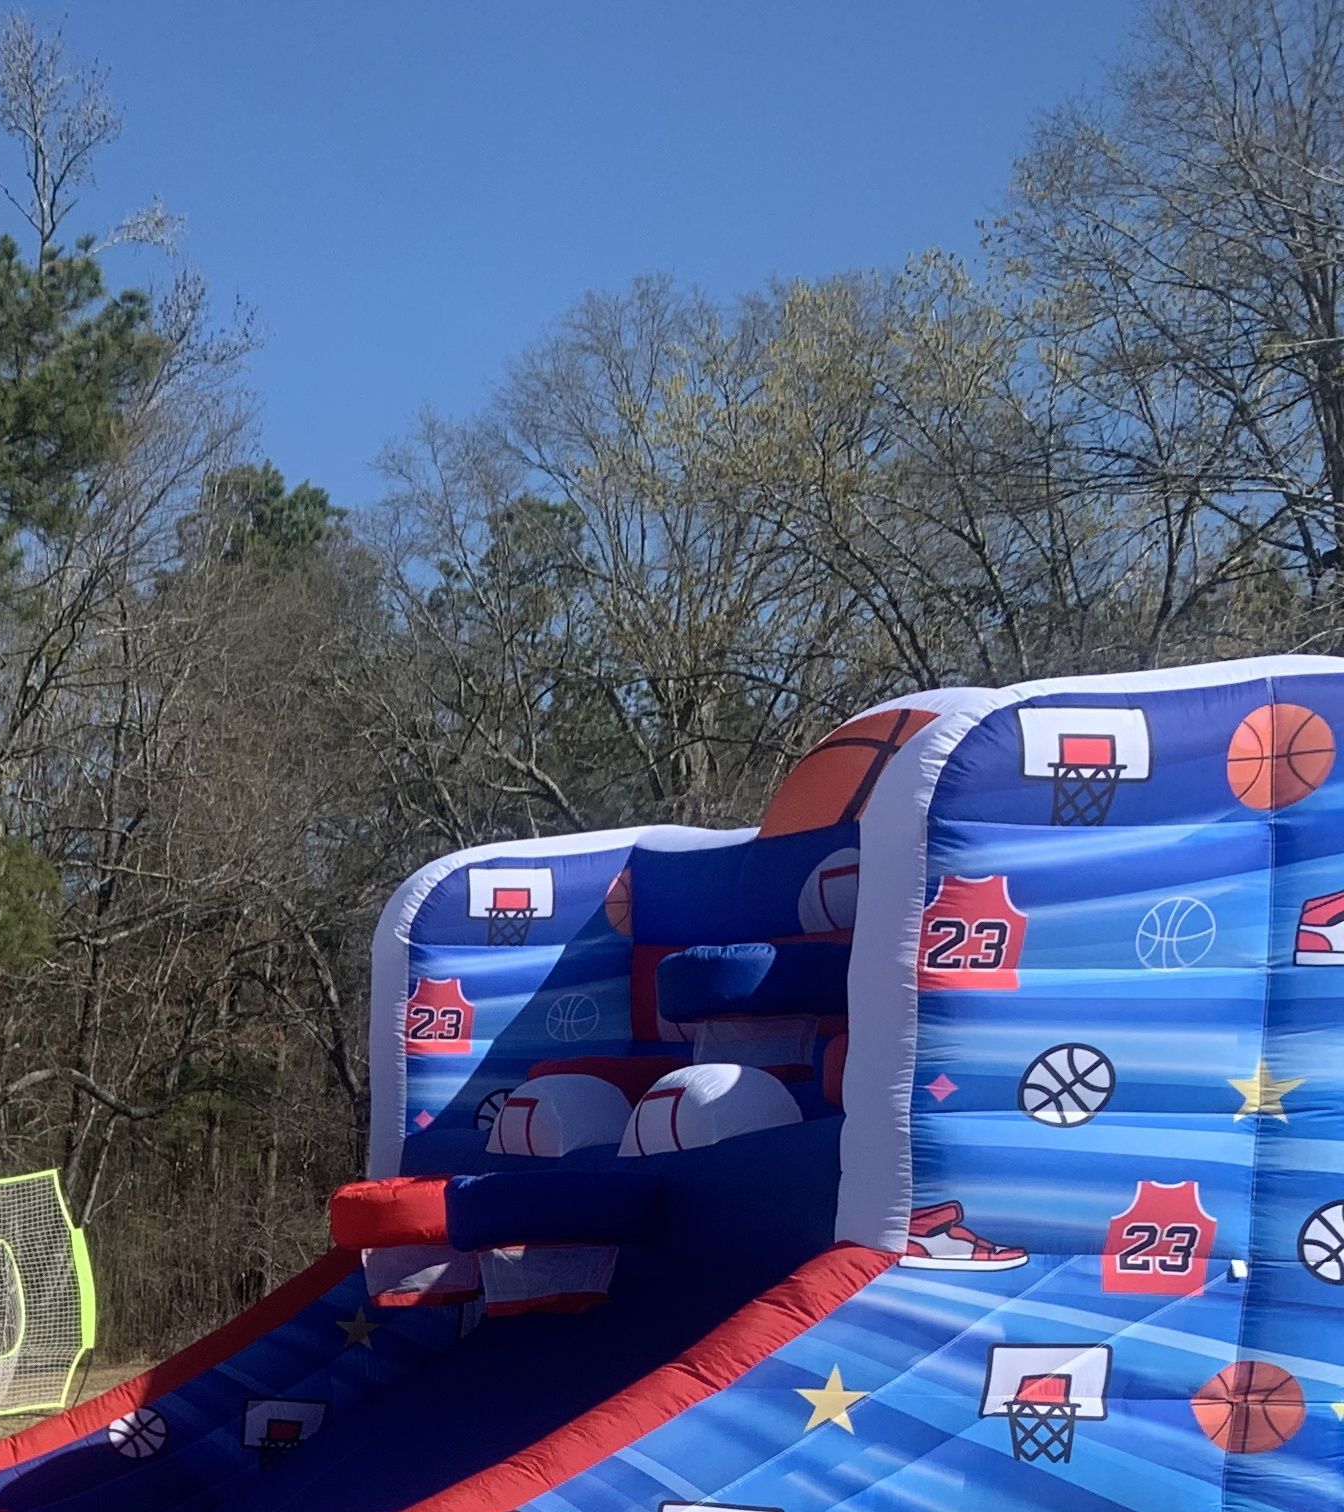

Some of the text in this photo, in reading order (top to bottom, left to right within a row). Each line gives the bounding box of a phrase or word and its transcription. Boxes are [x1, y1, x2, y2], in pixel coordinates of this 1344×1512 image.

[924, 918, 1009, 972] 23
[409, 1007, 463, 1041] 23
[1115, 1222, 1204, 1275] 23
